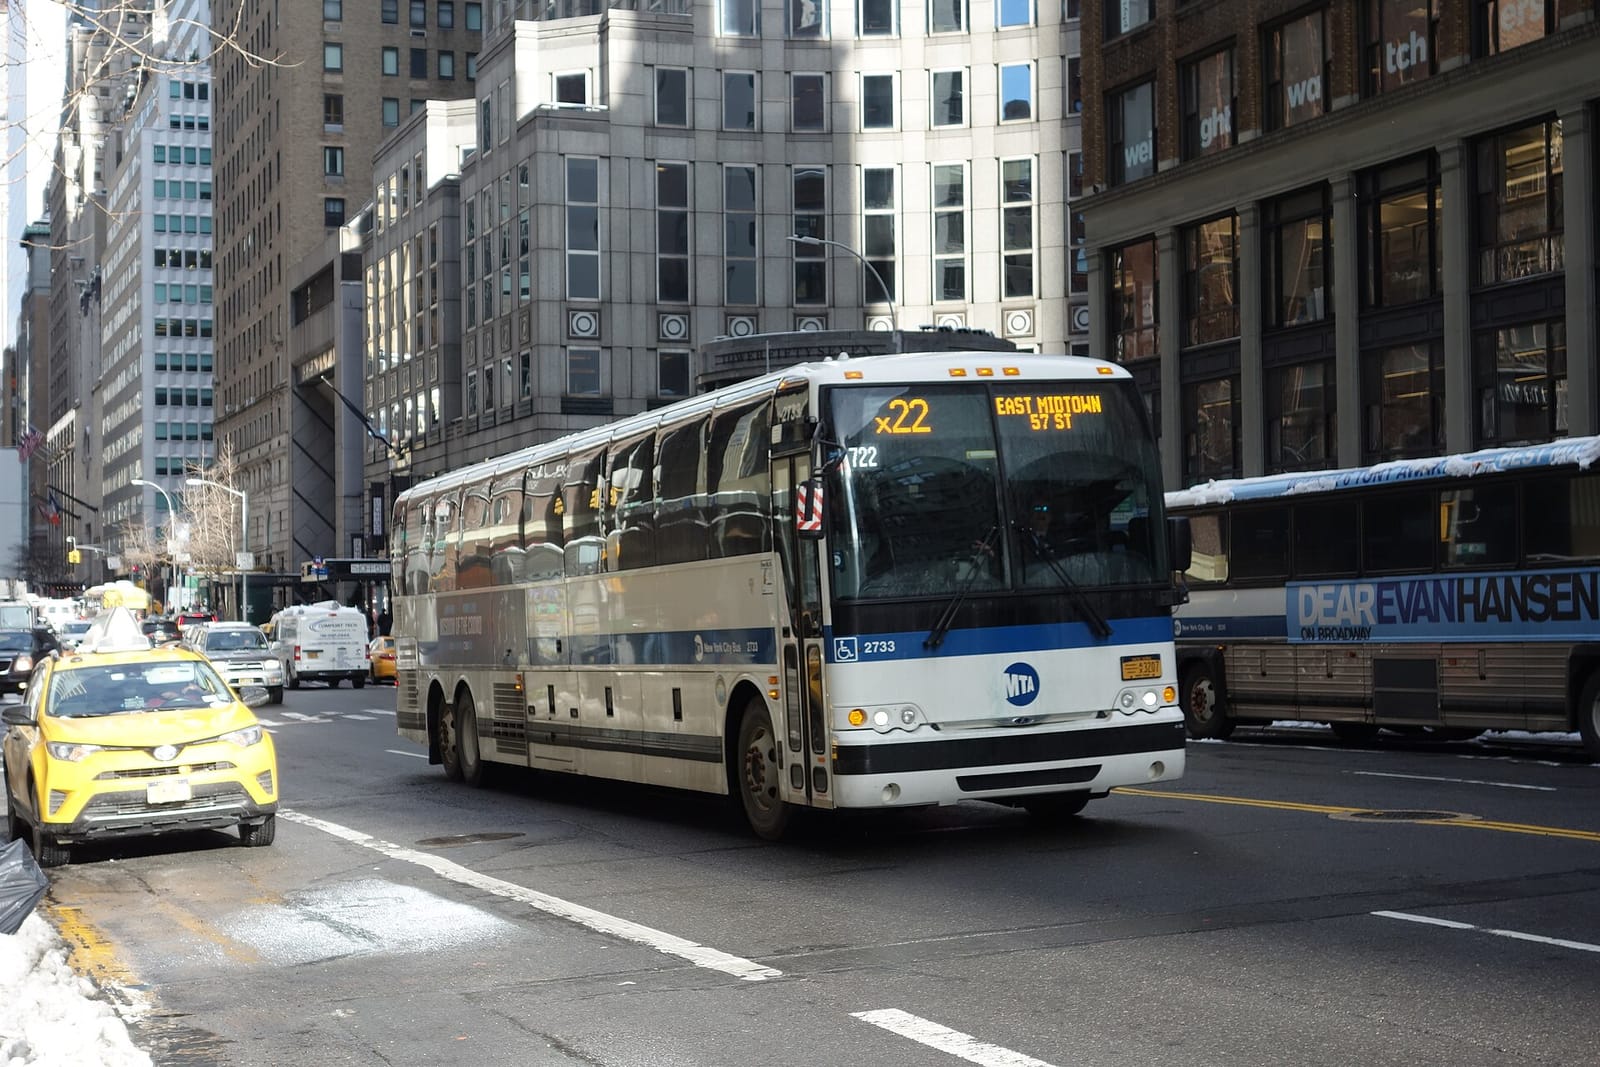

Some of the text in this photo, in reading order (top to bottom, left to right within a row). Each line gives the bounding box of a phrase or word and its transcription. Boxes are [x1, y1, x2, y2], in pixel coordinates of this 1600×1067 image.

[1385, 30, 1427, 74] tch
[995, 395, 1102, 416] EAST MIDTOWN
[1029, 413, 1074, 430] 57 ST
[1298, 573, 1599, 626] DEAR EVAN HANSEN
[1301, 626, 1371, 641] ON BROADWAY
[863, 639, 896, 654] 2733
[1003, 672, 1036, 699] MTA
